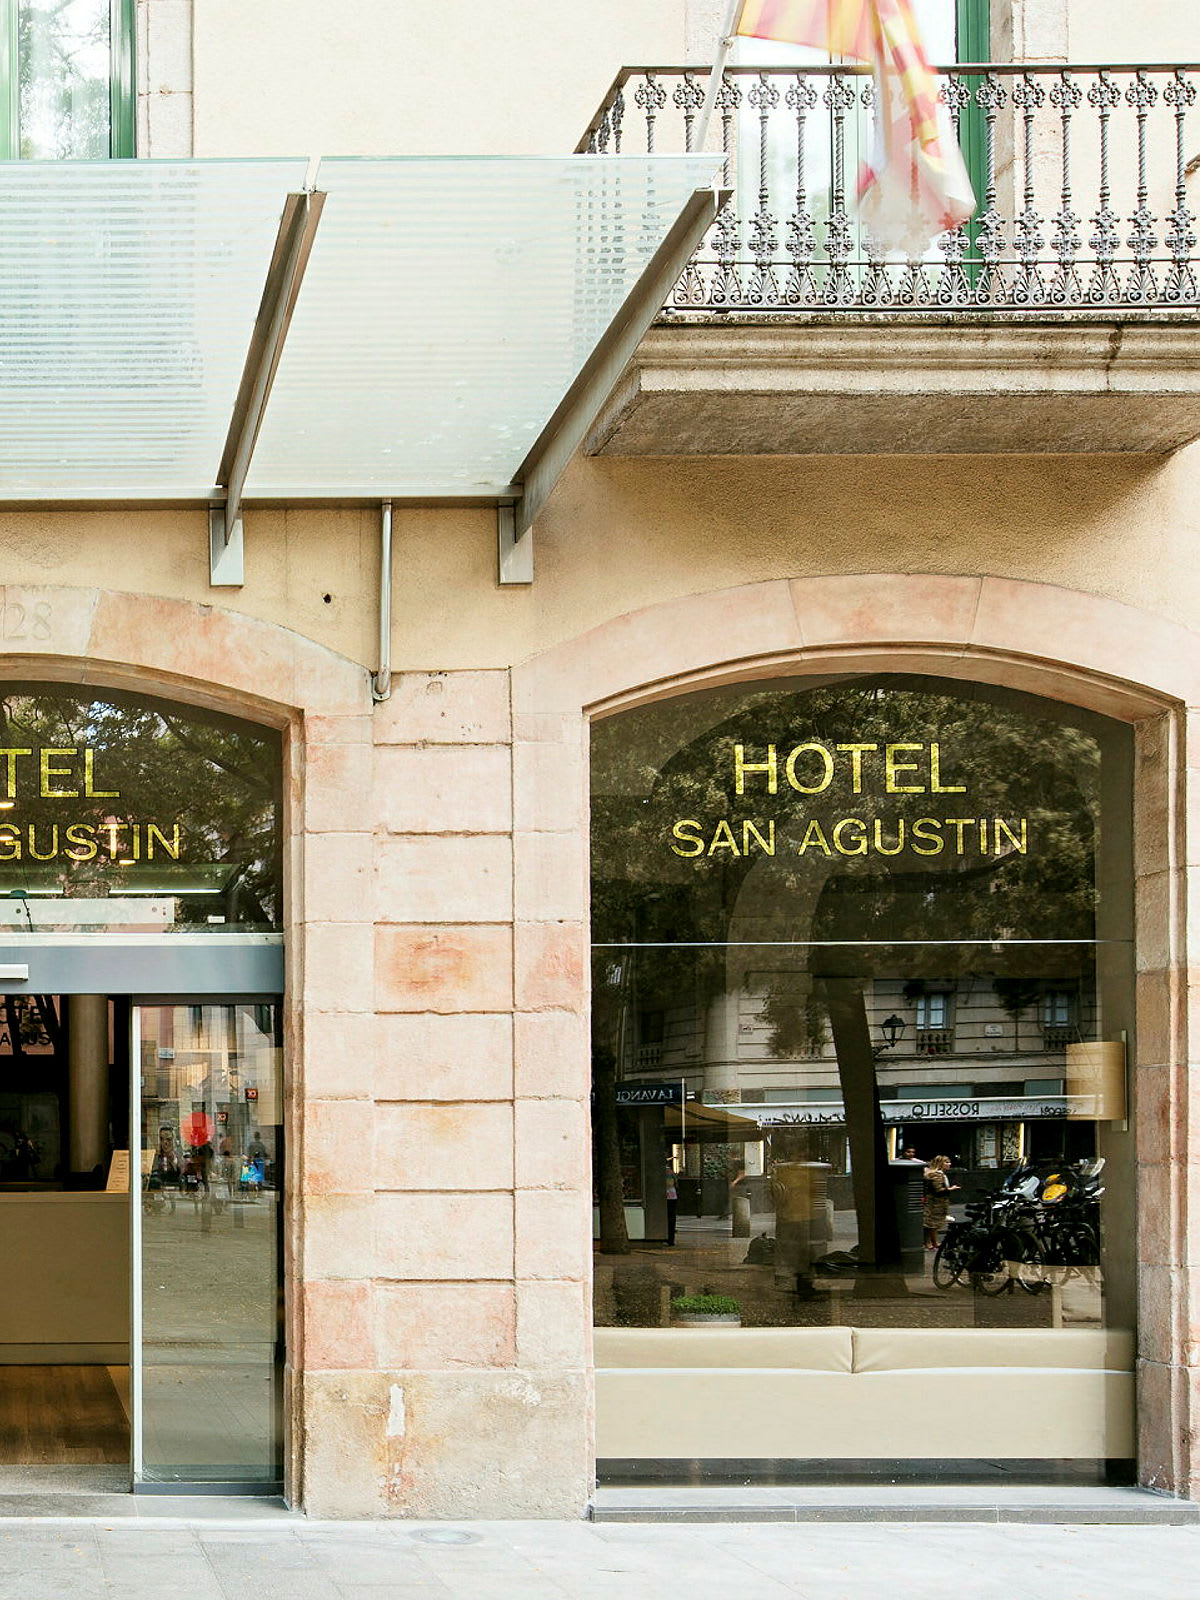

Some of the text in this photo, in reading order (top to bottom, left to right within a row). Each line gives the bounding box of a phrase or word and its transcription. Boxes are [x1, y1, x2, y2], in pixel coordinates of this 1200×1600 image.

[734, 742, 967, 795] HOTEL
[671, 818, 1028, 857] SAN AGUSTIN
